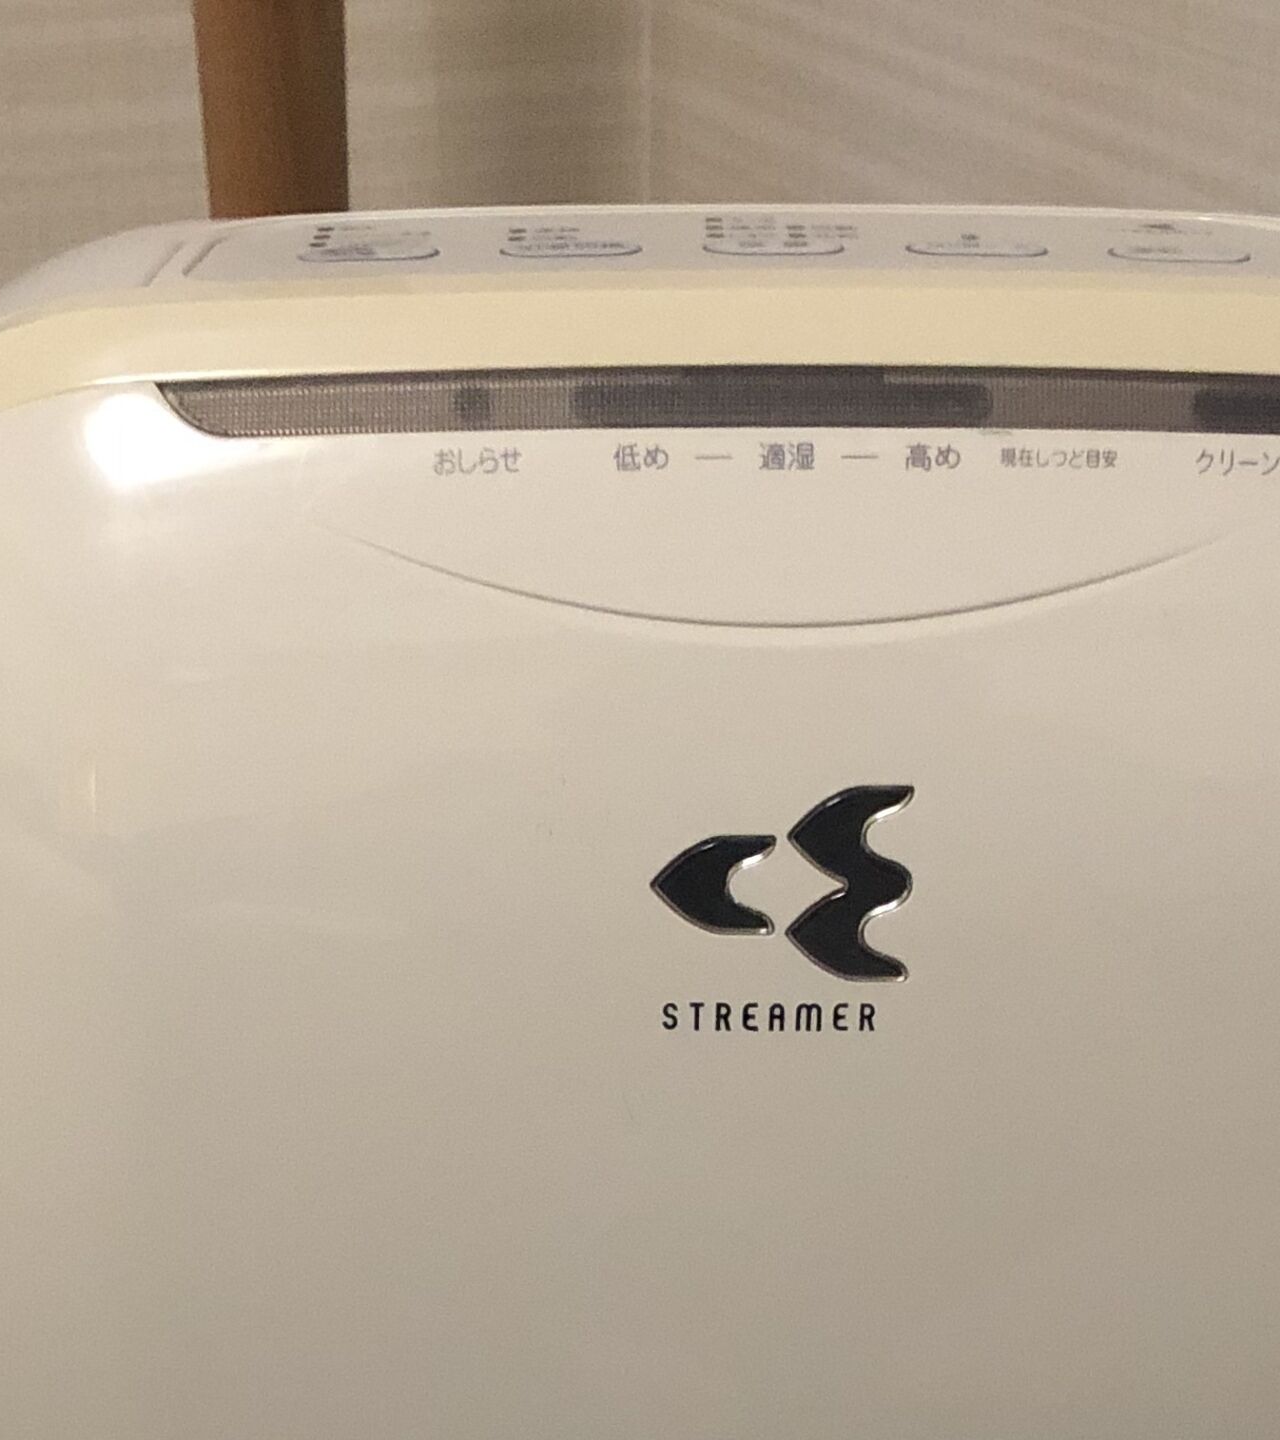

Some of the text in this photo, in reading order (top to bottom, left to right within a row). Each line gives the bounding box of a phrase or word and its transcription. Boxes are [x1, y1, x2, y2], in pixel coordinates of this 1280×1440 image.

[433, 446, 522, 475] おしらせ
[613, 442, 962, 472] 低め 適湿 高め
[999, 447, 1119, 470] 現在しつど目安
[662, 1002, 876, 1033] STREAMER
